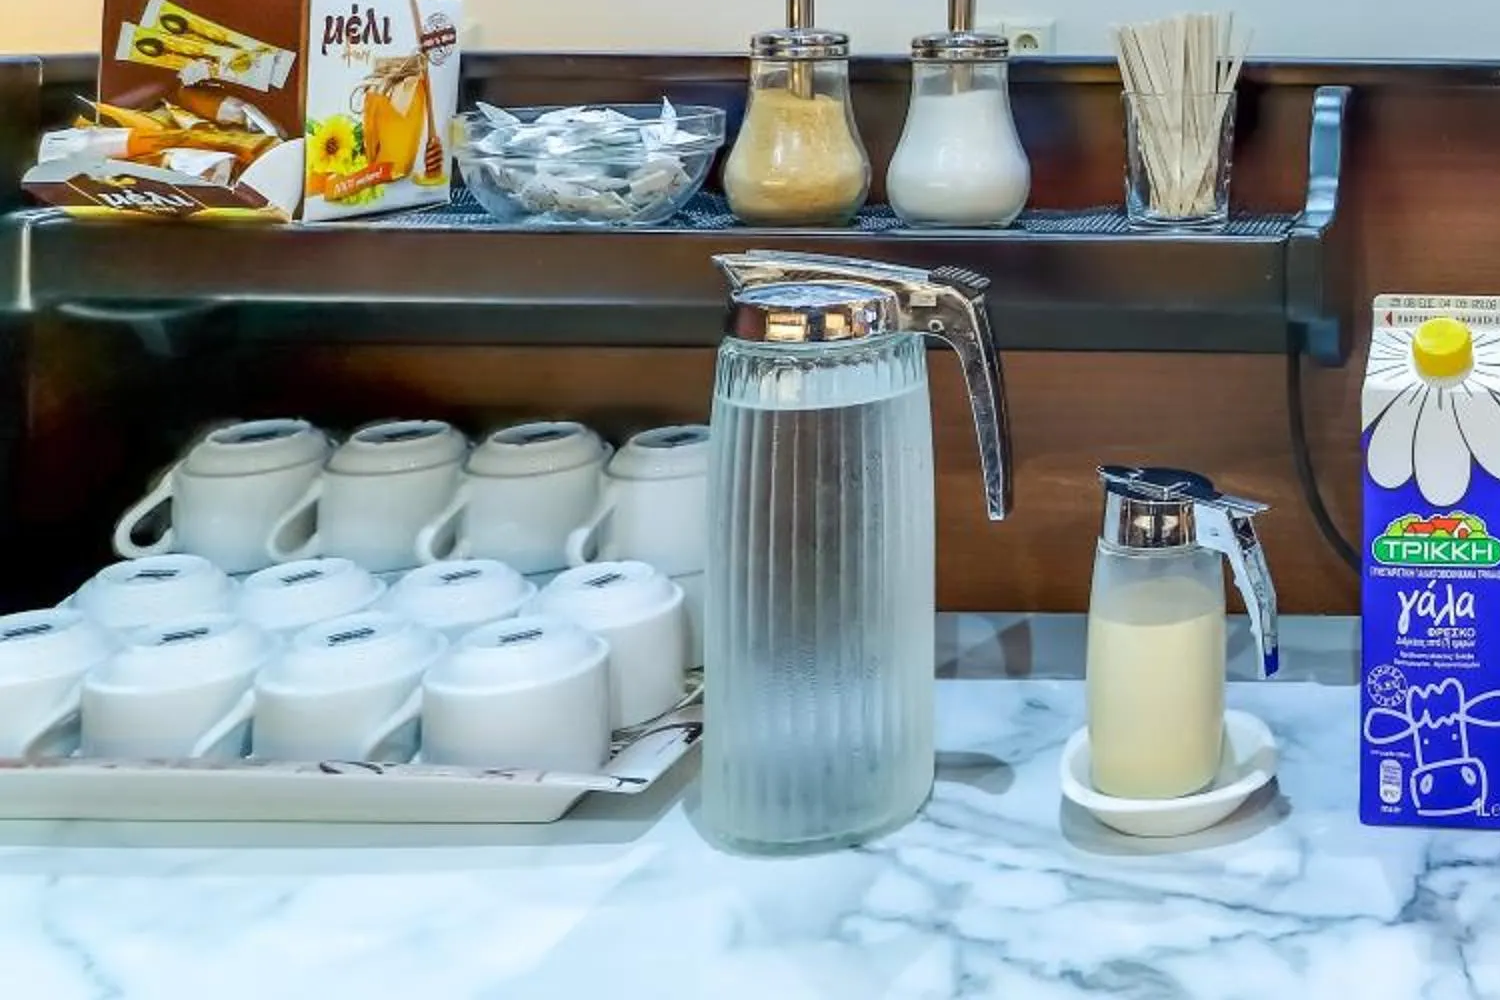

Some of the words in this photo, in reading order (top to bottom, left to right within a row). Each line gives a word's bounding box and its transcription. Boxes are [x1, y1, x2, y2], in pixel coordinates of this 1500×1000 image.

[321, 3, 392, 56] μέλι
[1382, 540, 1493, 562] ΤΡΙΚΚΗ
[1397, 579, 1476, 636] γάλα
